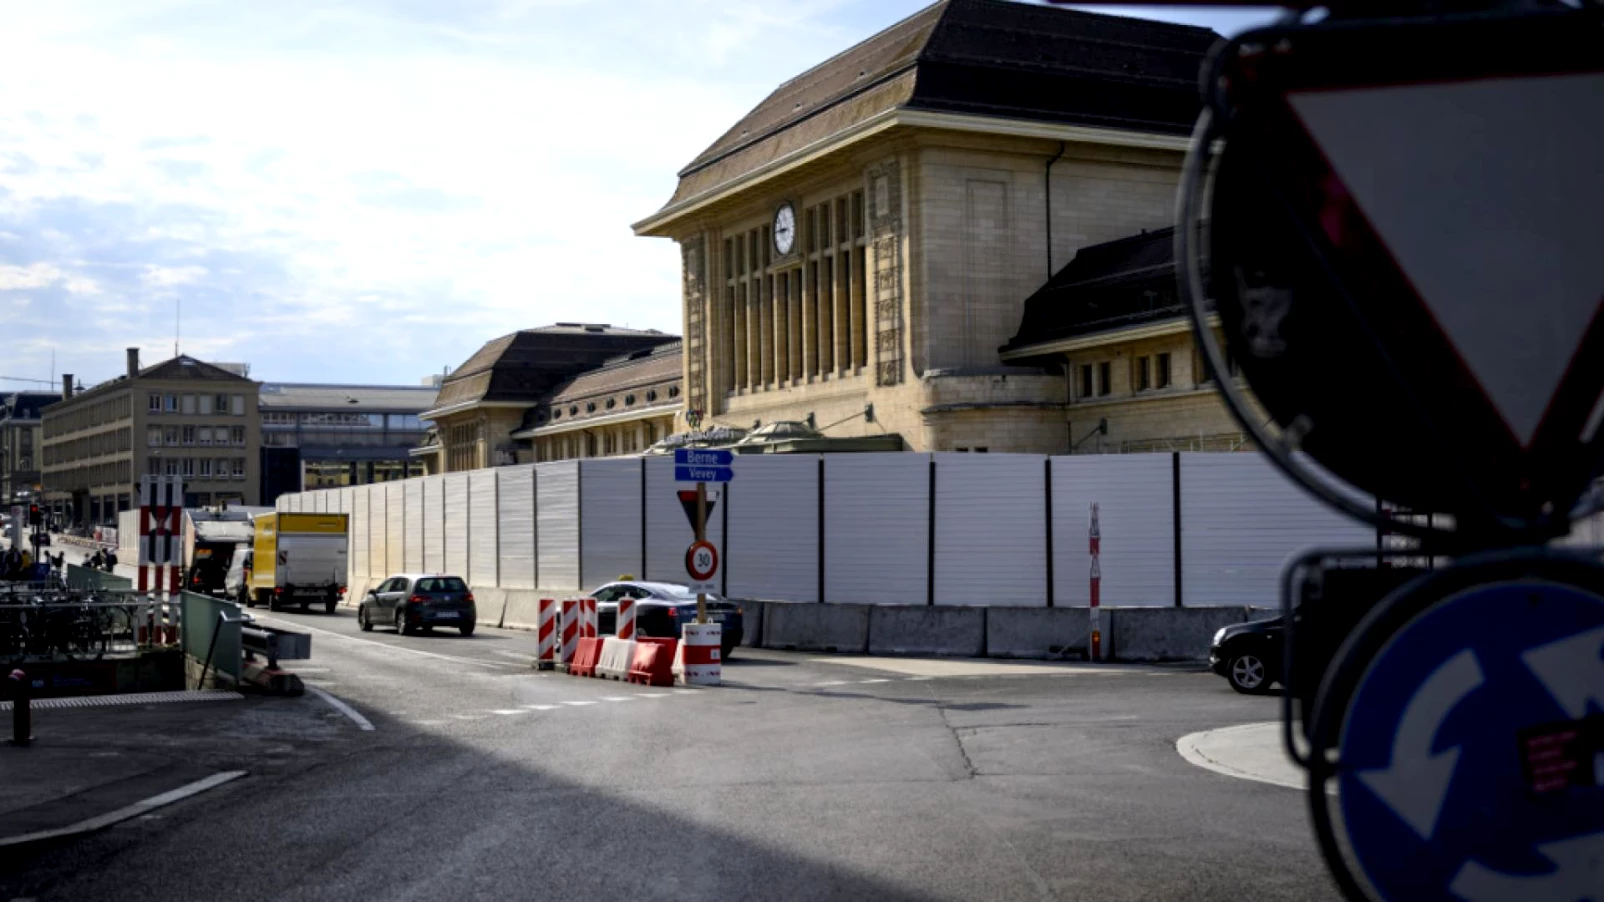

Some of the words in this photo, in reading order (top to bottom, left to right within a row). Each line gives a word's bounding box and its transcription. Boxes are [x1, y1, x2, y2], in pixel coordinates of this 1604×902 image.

[687, 450, 718, 464] Berne
[688, 467, 716, 481] Vevey
[697, 553, 710, 567] 30
